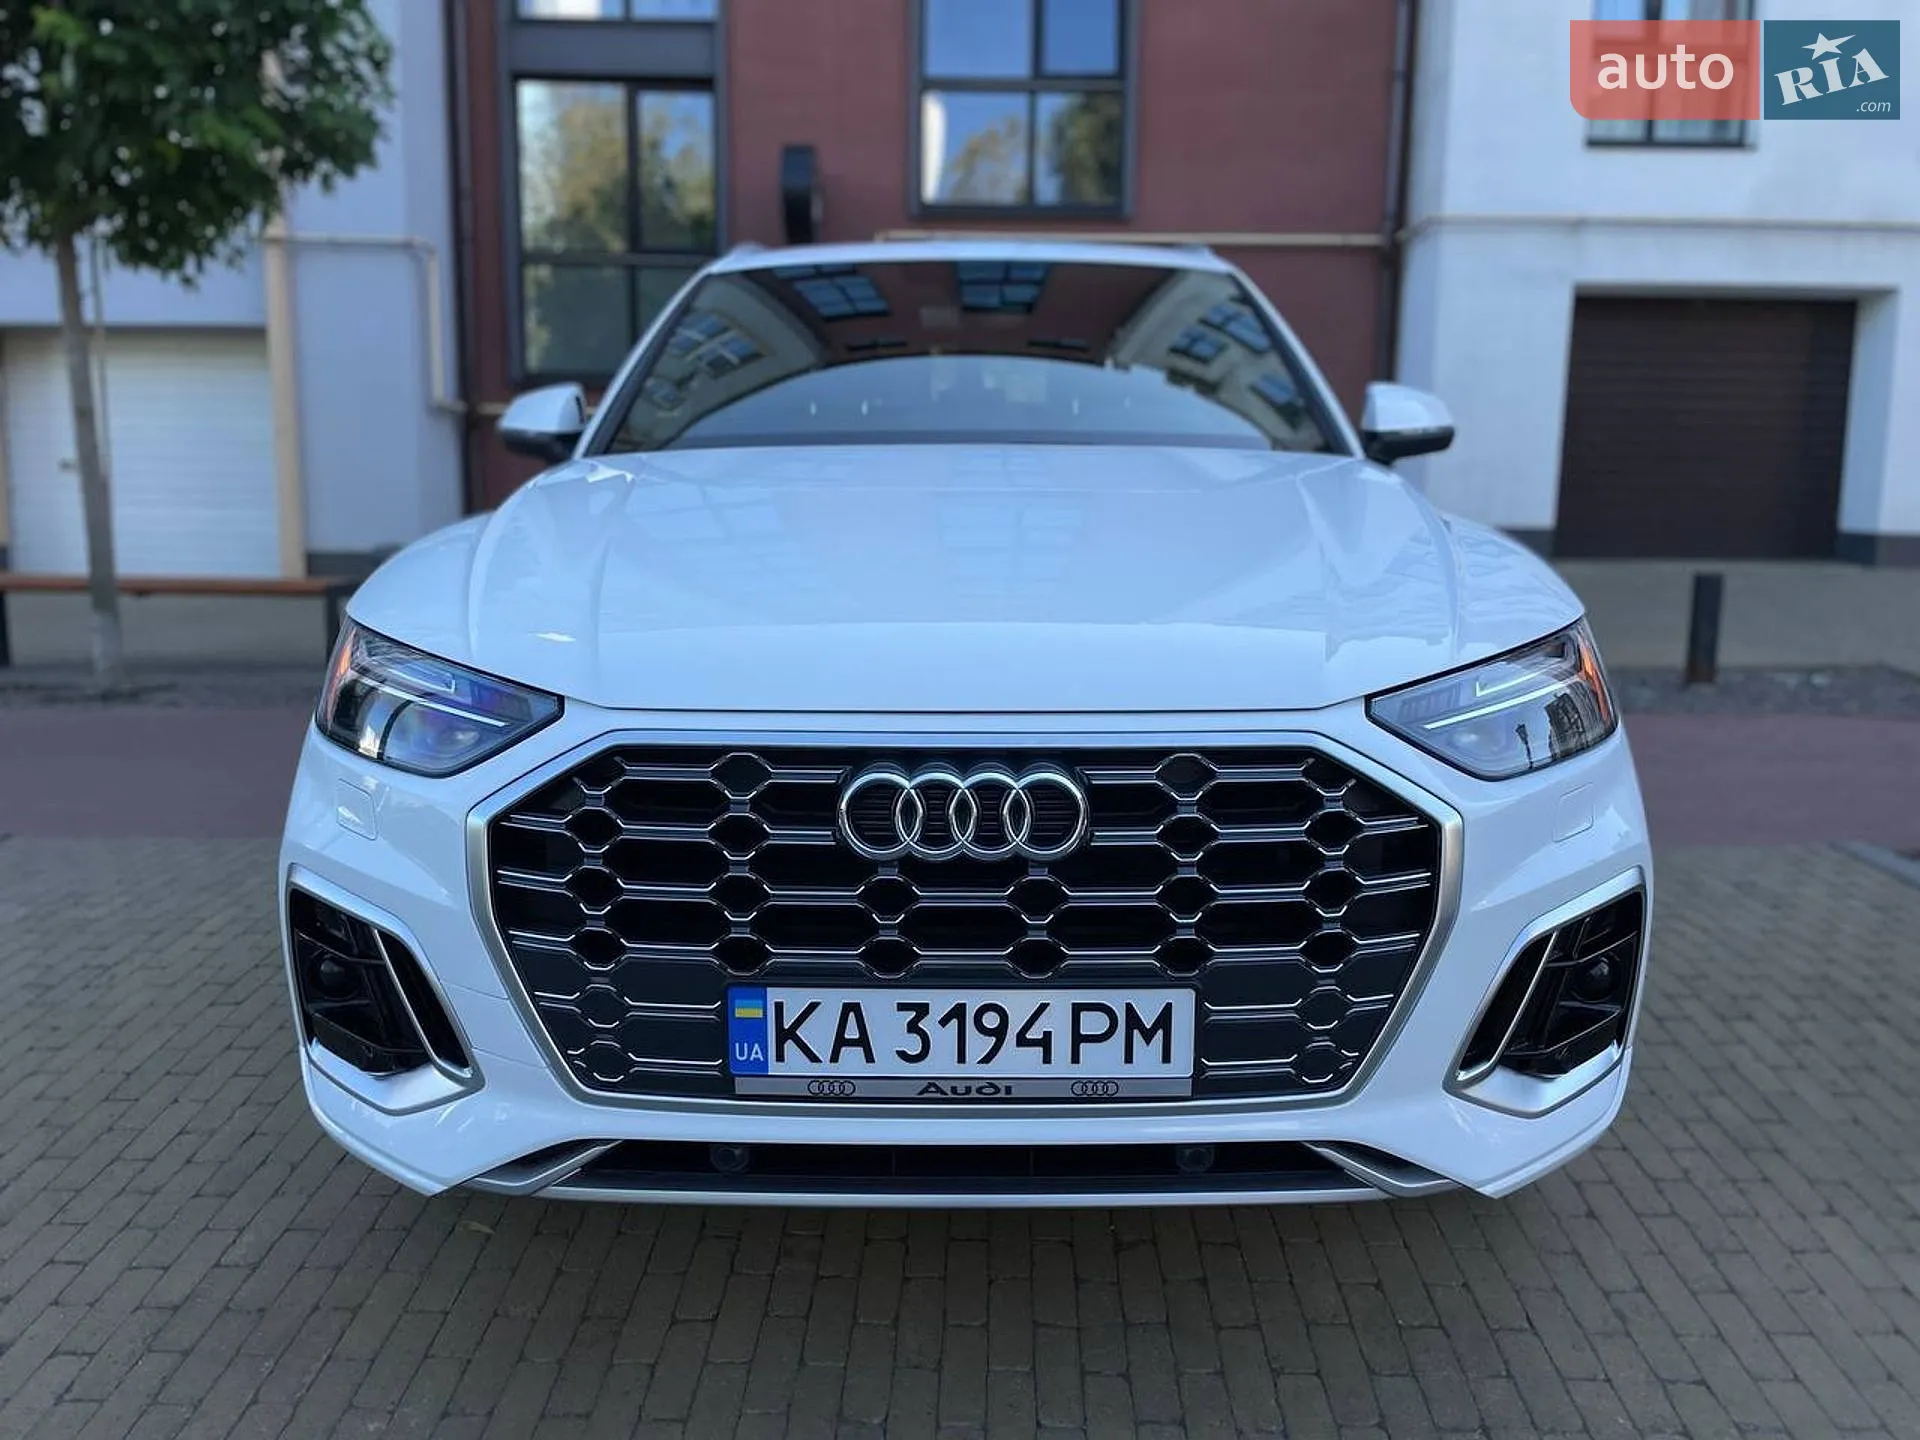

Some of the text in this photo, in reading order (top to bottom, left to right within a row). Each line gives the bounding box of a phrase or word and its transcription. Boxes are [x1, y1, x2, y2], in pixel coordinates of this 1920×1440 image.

[774, 1001, 1174, 1065] KA 3194 PM
[735, 1043, 764, 1062] UA
[916, 1081, 1013, 1097] Audi
